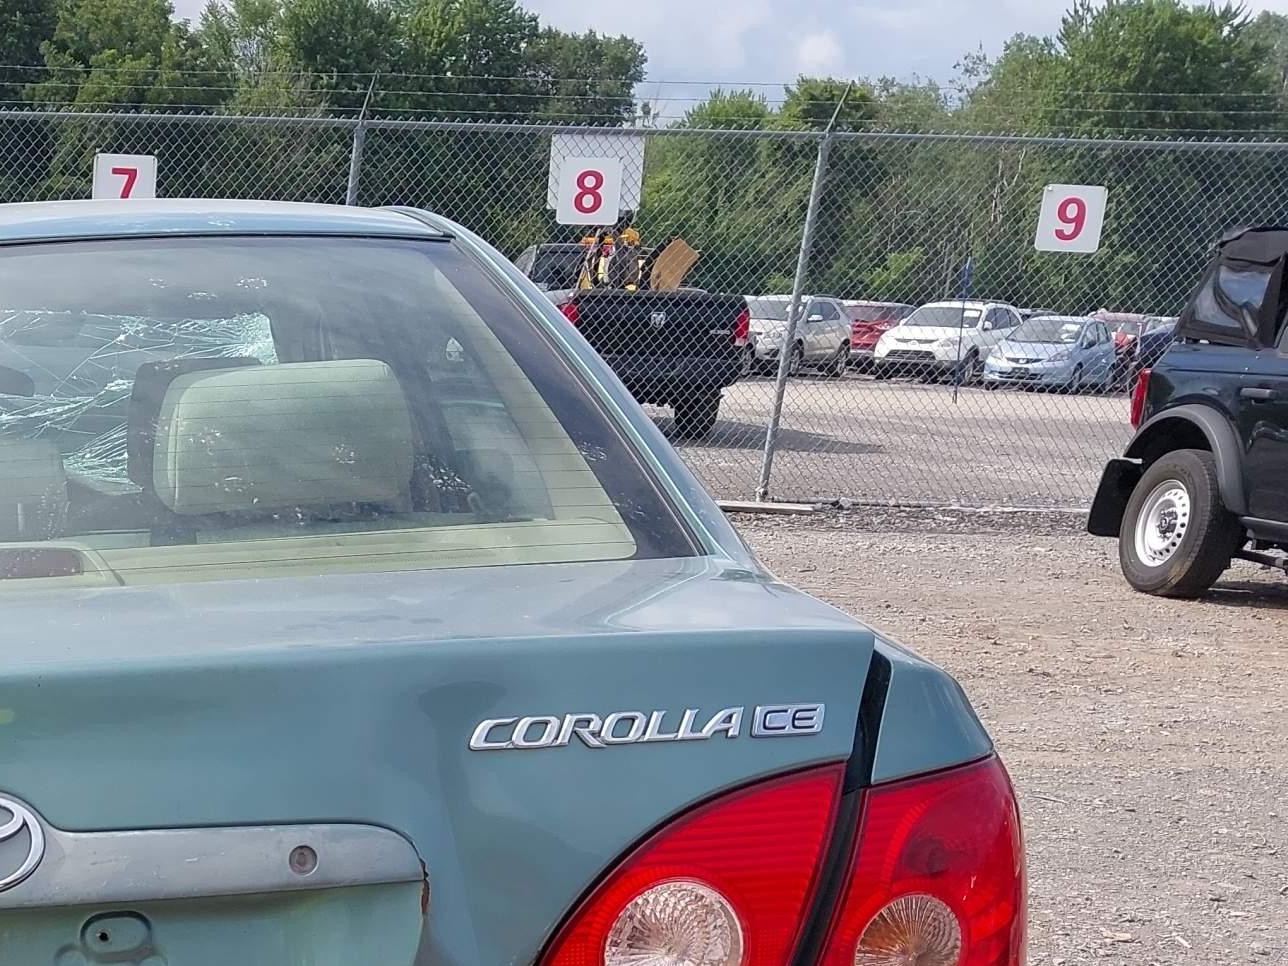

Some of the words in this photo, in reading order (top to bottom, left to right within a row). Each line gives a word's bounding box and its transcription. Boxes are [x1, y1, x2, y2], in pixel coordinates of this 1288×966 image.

[111, 167, 138, 199] 7
[573, 169, 604, 215] 8
[1053, 196, 1087, 242] 9
[469, 705, 744, 751] COROLLA
[758, 705, 822, 734] CE
